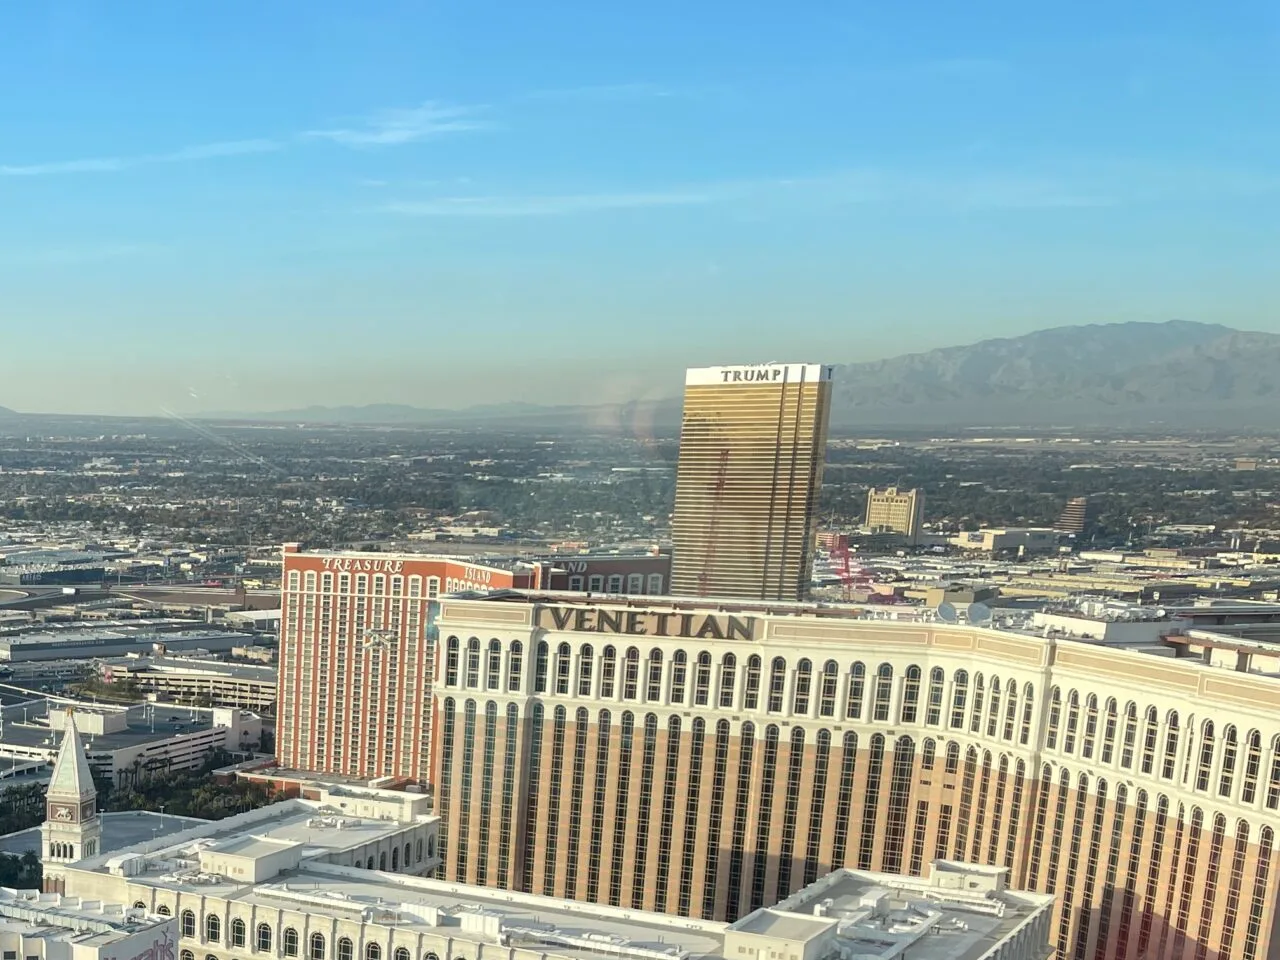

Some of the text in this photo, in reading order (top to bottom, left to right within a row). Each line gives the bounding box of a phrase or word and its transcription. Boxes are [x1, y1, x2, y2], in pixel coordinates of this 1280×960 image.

[721, 369, 781, 382] TRUMP
[323, 558, 404, 573] TREASURE
[464, 567, 491, 583] ISLAND
[549, 606, 756, 641] VENETIAN
